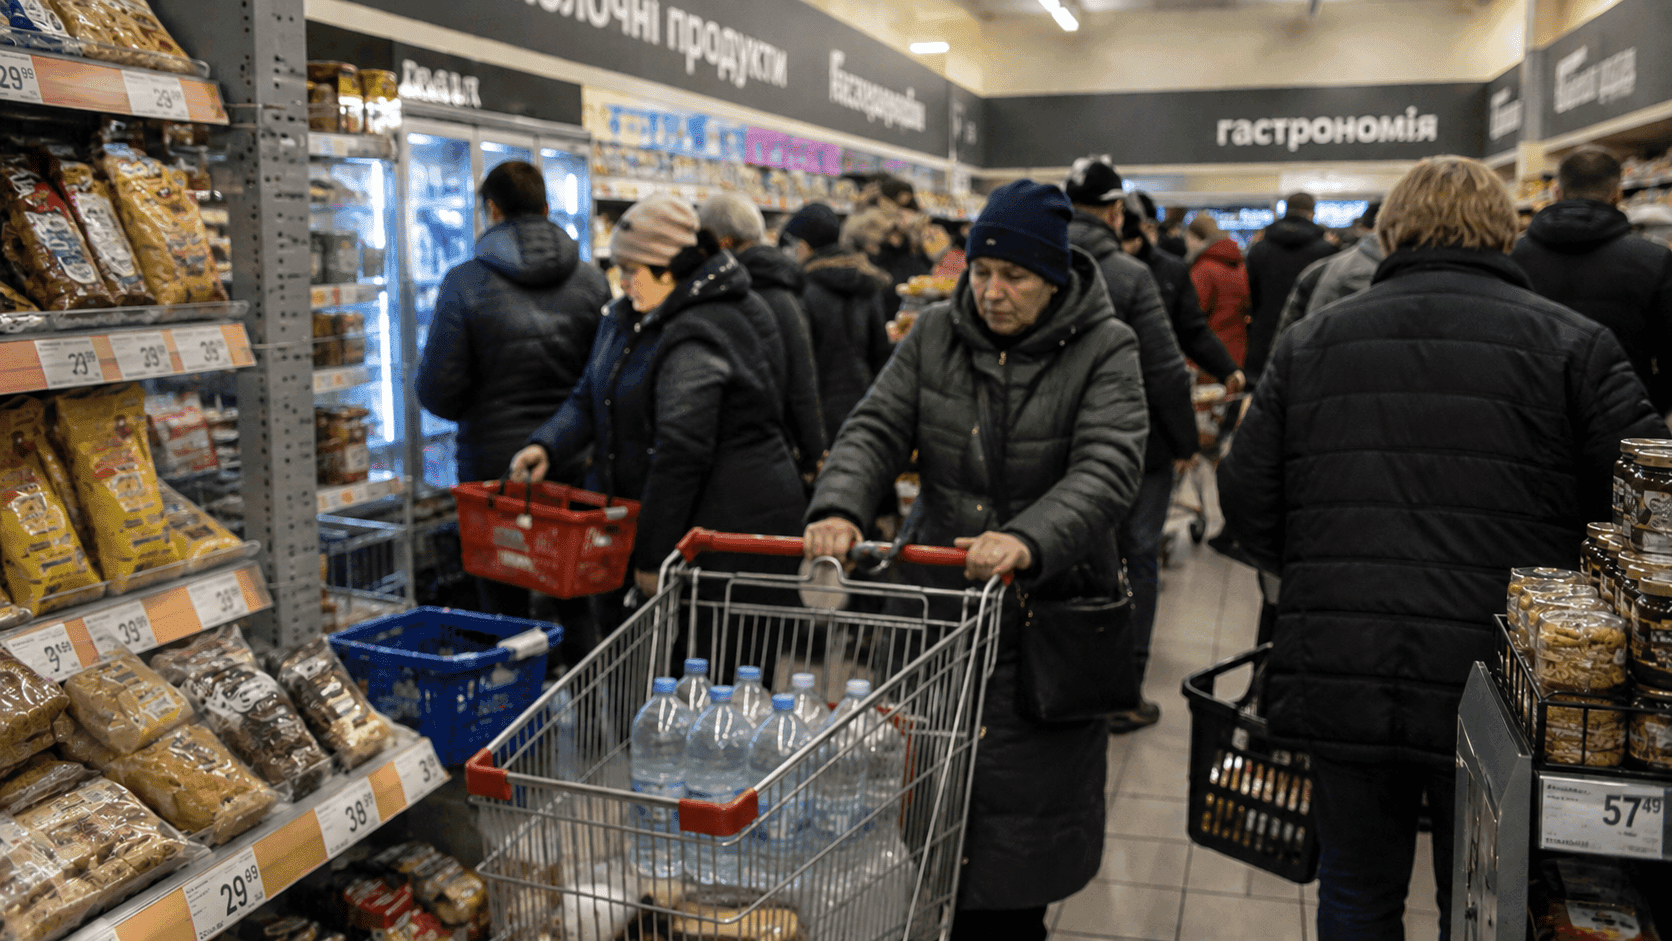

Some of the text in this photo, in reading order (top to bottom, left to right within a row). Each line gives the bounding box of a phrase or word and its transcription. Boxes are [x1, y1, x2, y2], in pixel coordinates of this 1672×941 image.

[666, 6, 788, 87] продукти
[1215, 104, 1439, 153] гастрономія
[345, 799, 367, 833] 38
[1602, 793, 1662, 828] 57 49
[220, 875, 249, 917] 29
